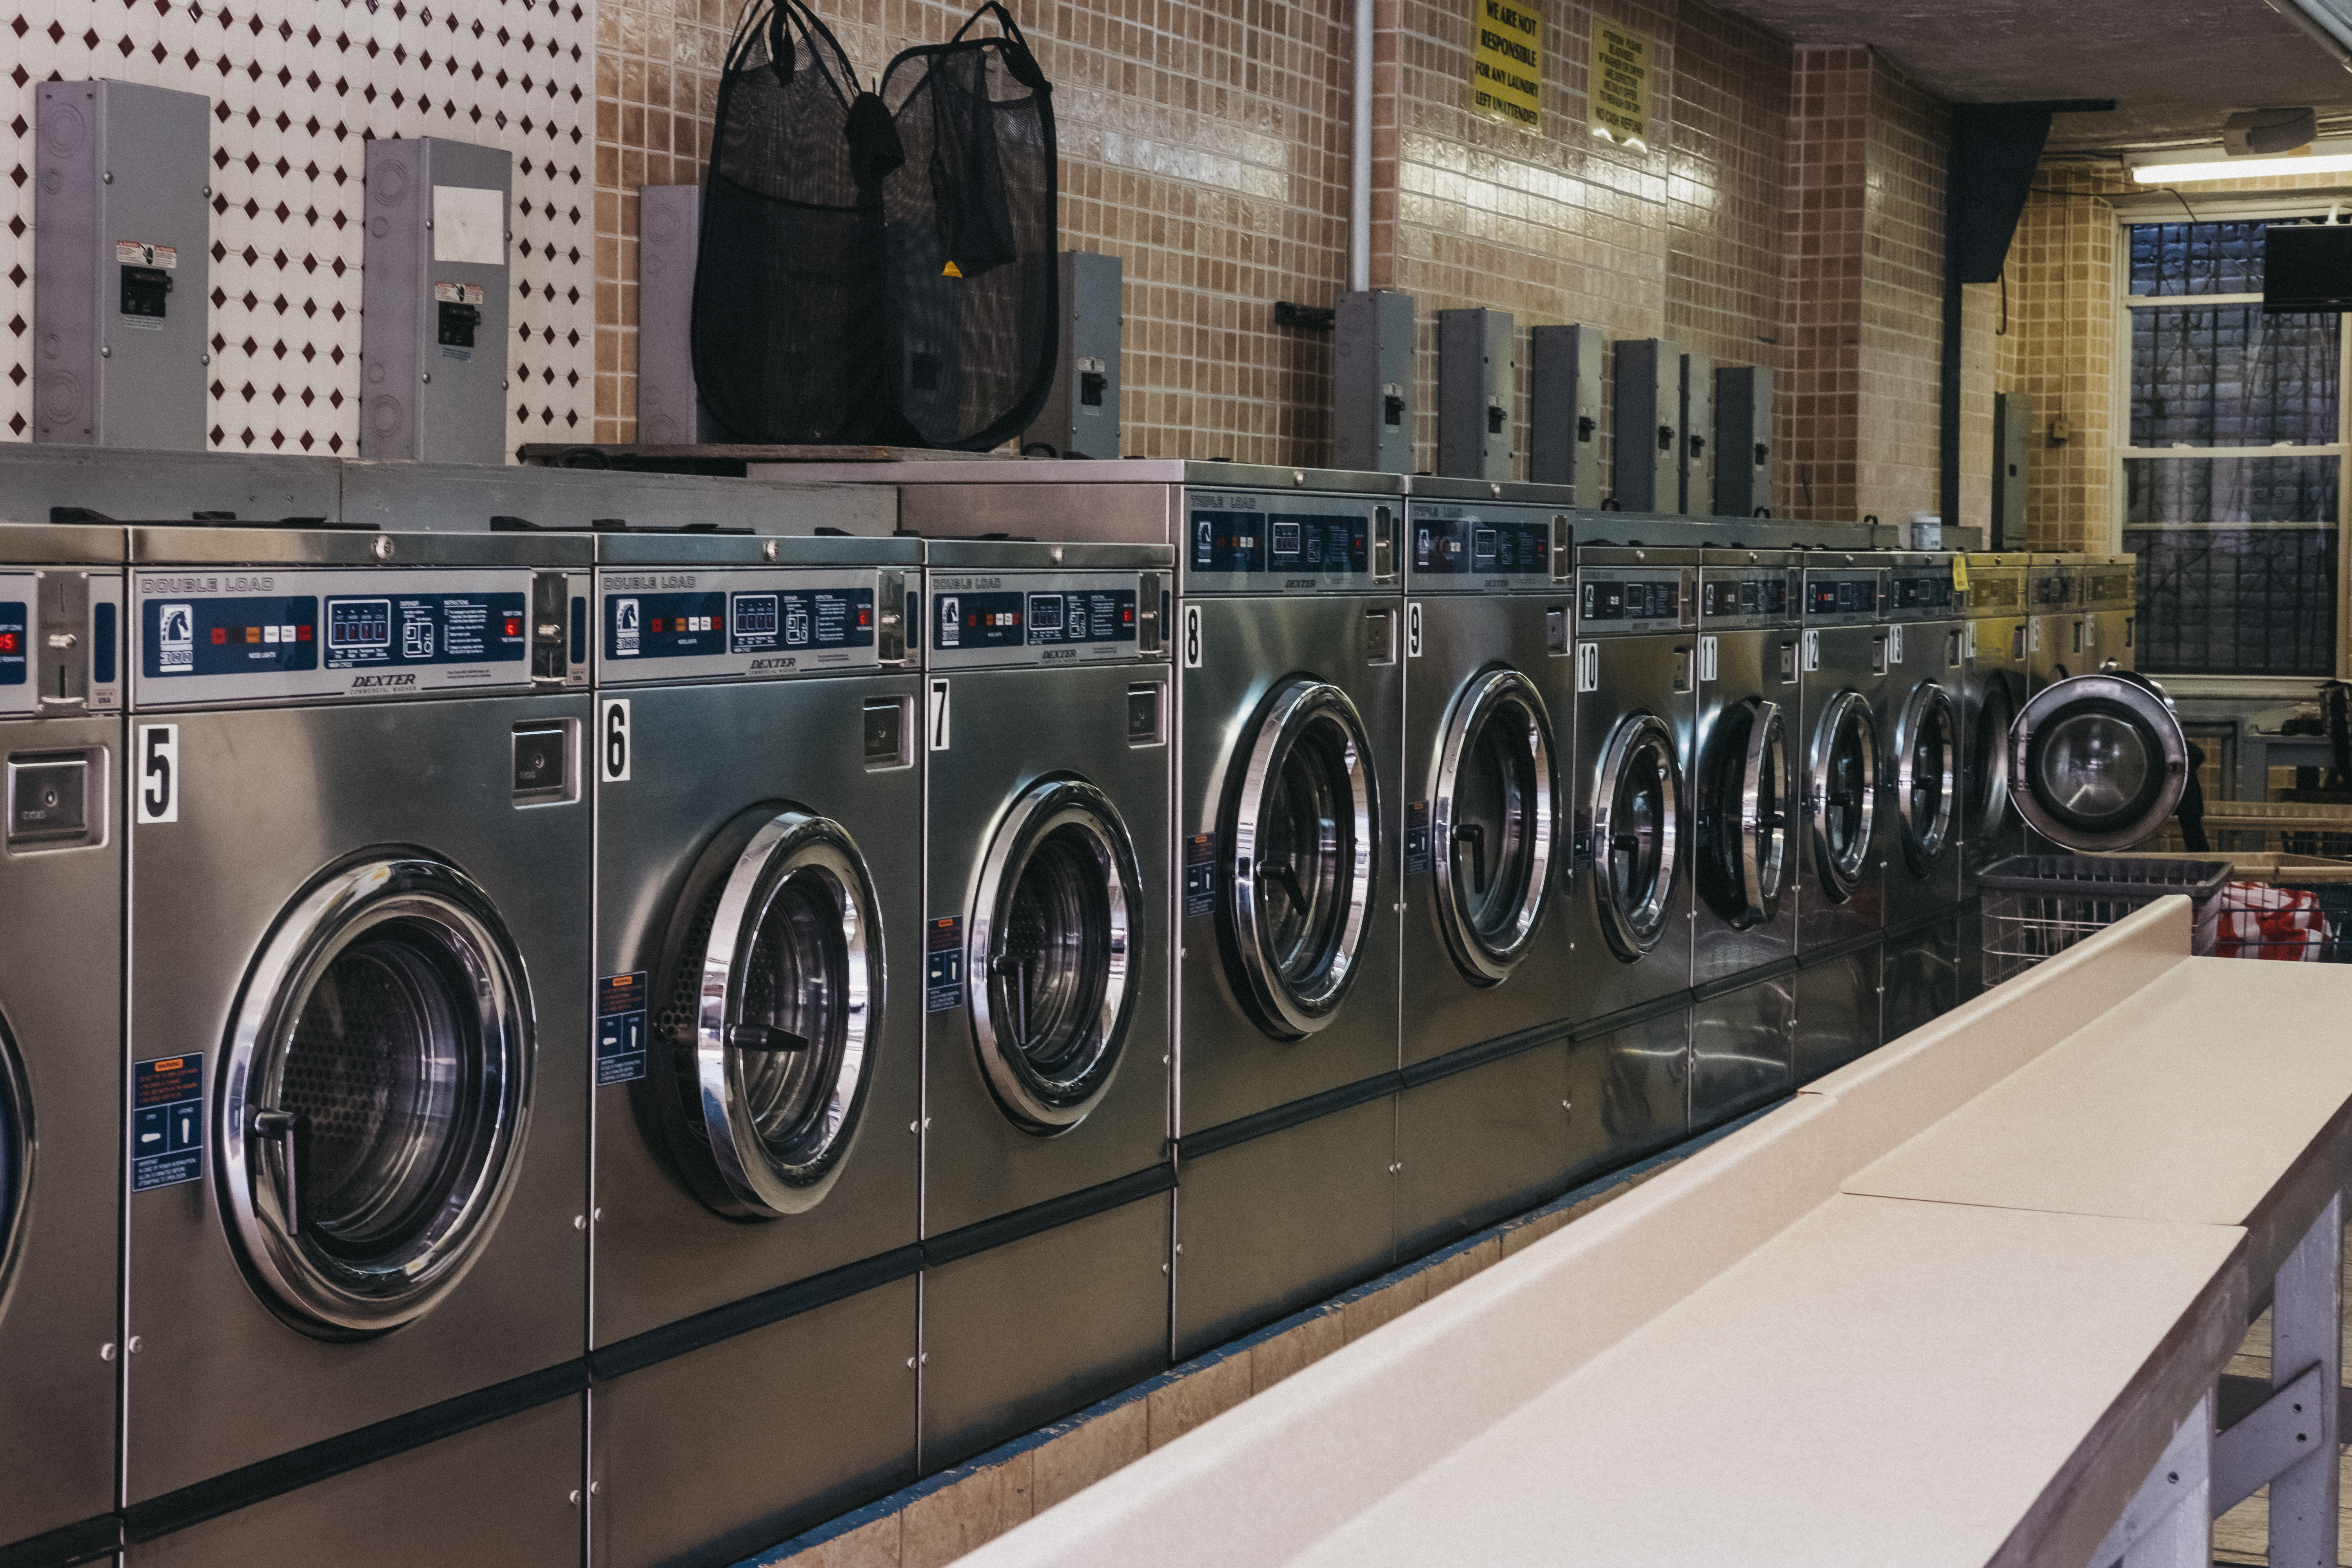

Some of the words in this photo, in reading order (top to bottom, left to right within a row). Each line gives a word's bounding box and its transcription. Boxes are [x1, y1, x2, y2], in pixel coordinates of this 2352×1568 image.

[1486, 0, 1499, 20] WE
[1499, 6, 1517, 28] ARE
[1518, 13, 1537, 36] NOT
[1481, 29, 1536, 67] RESPONSIBLE
[1475, 60, 1490, 80] FOR
[1491, 67, 1506, 85] ANY
[1507, 72, 1539, 98] LAUNDRY
[1475, 90, 1492, 109] LEFT
[1492, 96, 1538, 125] UNATTENDED
[1230, 496, 1256, 509] LOAD
[142, 578, 218, 593] DOUBLE
[225, 577, 274, 592] LOAD
[604, 577, 657, 590] DOUBLE
[661, 576, 696, 588] LOAD
[933, 578, 973, 590] DOUBLE
[975, 577, 1002, 589] LOAD
[1189, 608, 1198, 664] 8
[1412, 606, 1419, 654] 9
[160, 650, 193, 664] 300
[750, 657, 796, 669] DEXTER
[1582, 645, 1595, 689] 10
[1703, 638, 1715, 679] 11
[1807, 633, 1818, 669] 12
[351, 674, 416, 688] DEXTER
[933, 682, 947, 747] 7
[607, 703, 625, 777] 6
[145, 728, 170, 817] 5
